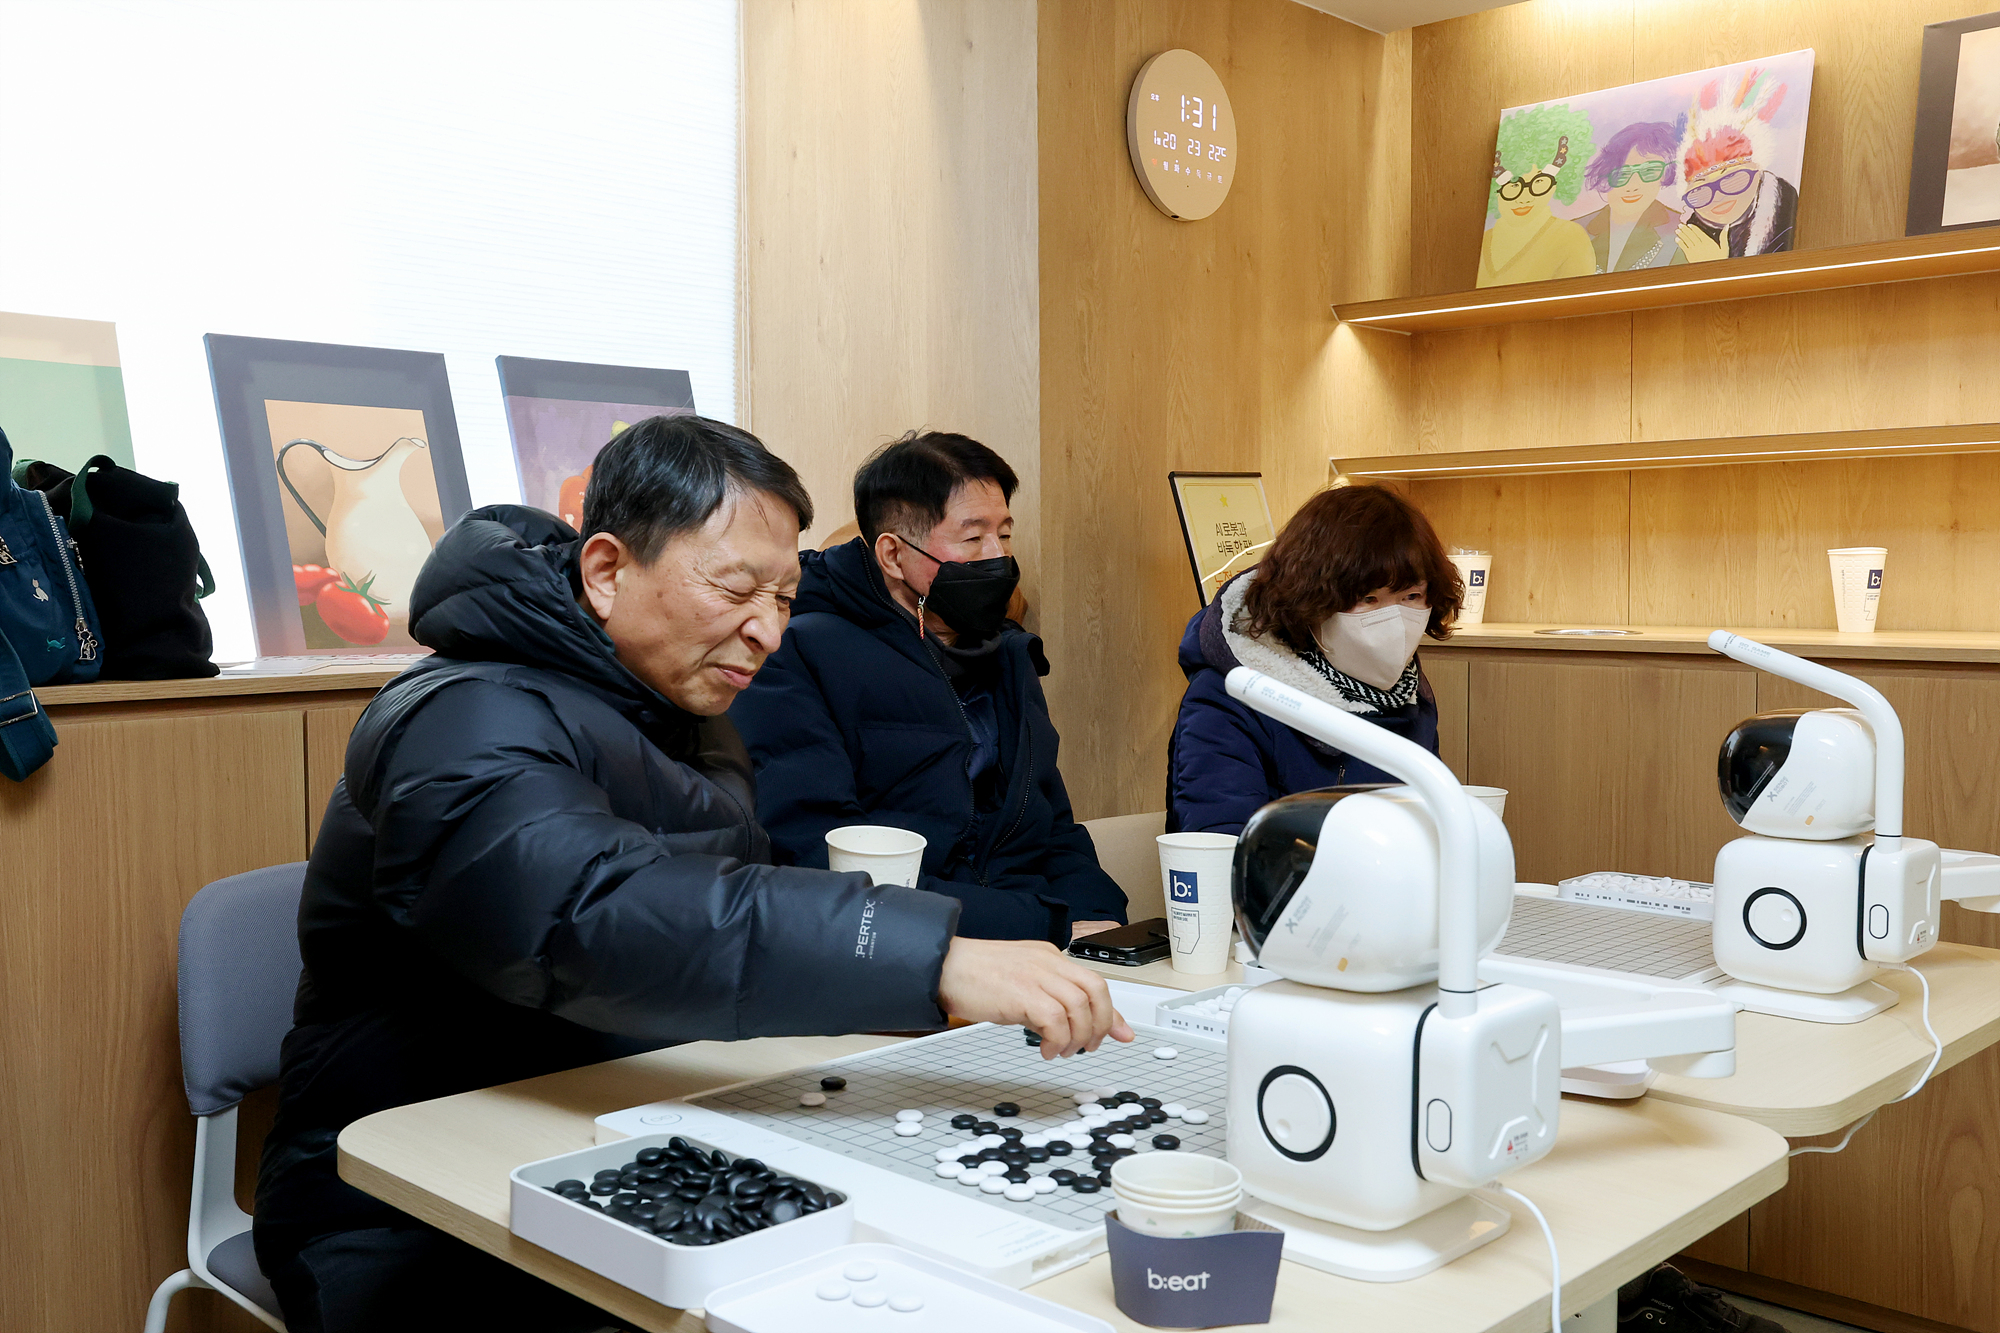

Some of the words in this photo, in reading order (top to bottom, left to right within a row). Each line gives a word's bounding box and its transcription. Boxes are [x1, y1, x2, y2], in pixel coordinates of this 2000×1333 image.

[1181, 94, 1217, 132] 1:31
[1187, 138, 1201, 157] 23
[856, 899, 876, 958] PERTEX
